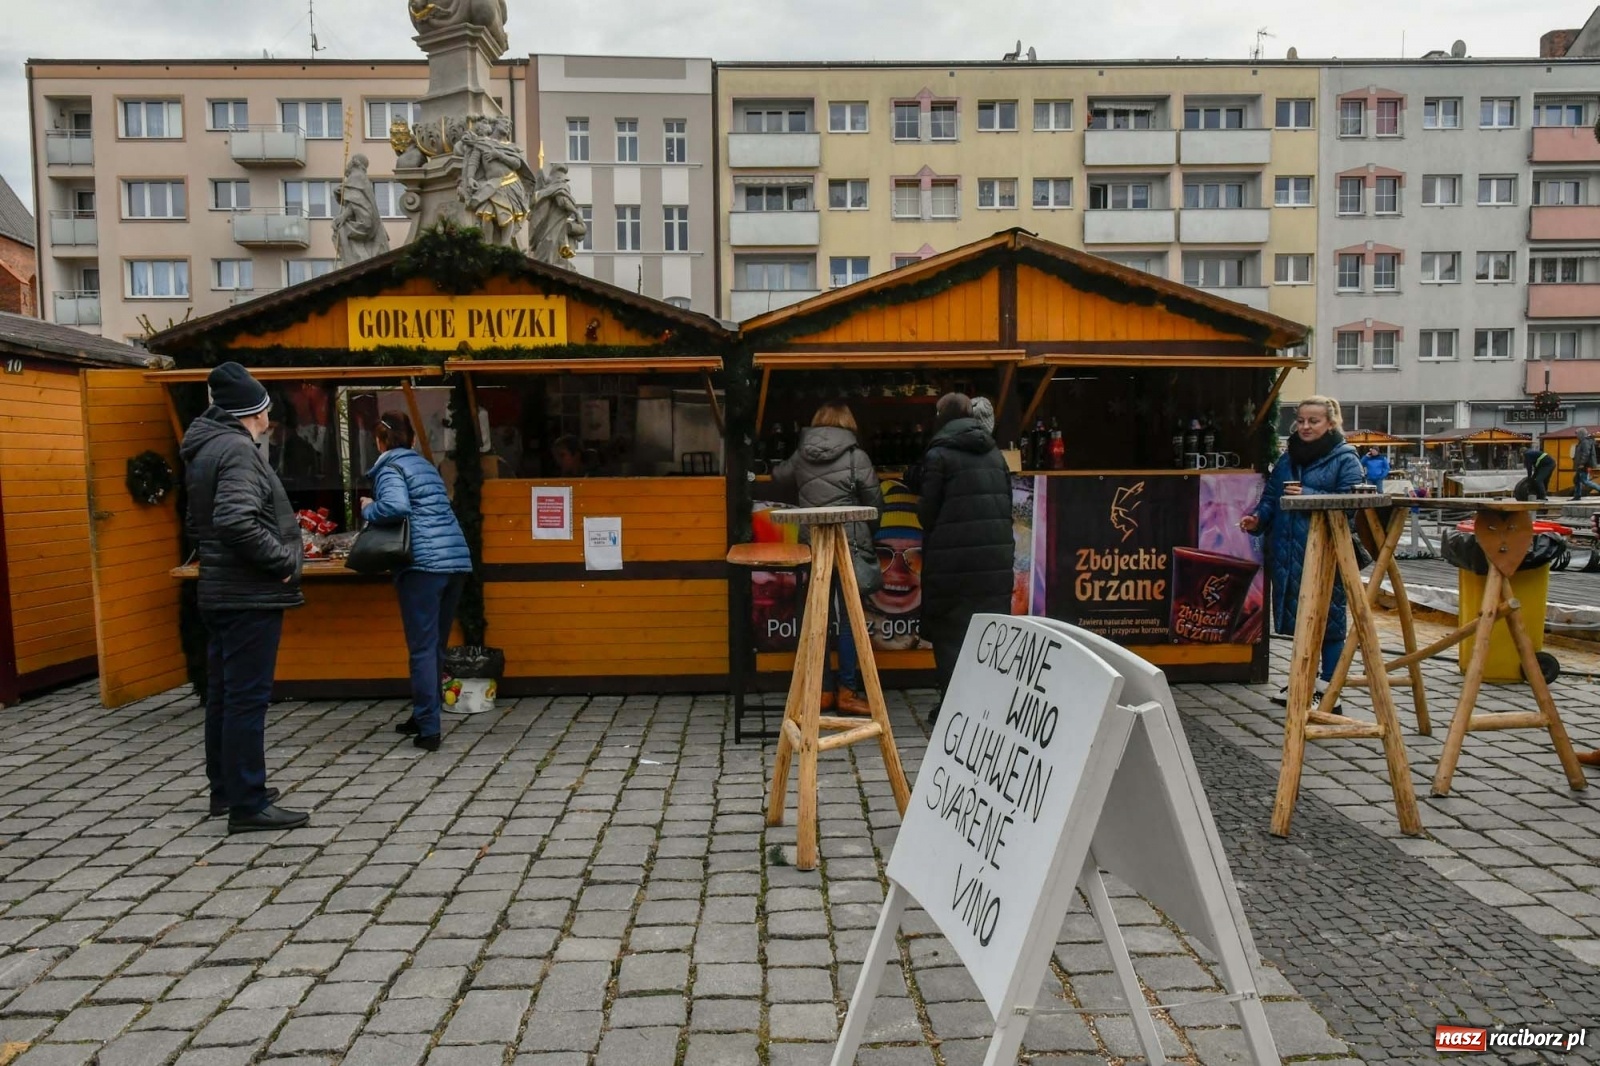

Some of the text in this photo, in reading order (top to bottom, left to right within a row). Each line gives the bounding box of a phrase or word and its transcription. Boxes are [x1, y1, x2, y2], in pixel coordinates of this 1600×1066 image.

[358, 308, 557, 343] GORĄCE PĄCZKI
[7, 359, 22, 373] 10
[1075, 547, 1167, 577] Zbójeckie
[1075, 572, 1166, 601] Grzane
[1078, 617, 1160, 627] Zawiera naturalne aromaty
[976, 621, 1062, 694] GRZANE
[1005, 687, 1059, 749] WINO
[943, 709, 1053, 824] GLÜHWEIN
[926, 766, 1018, 871] SVAŘENÉ
[952, 864, 1001, 947] VÍNO
